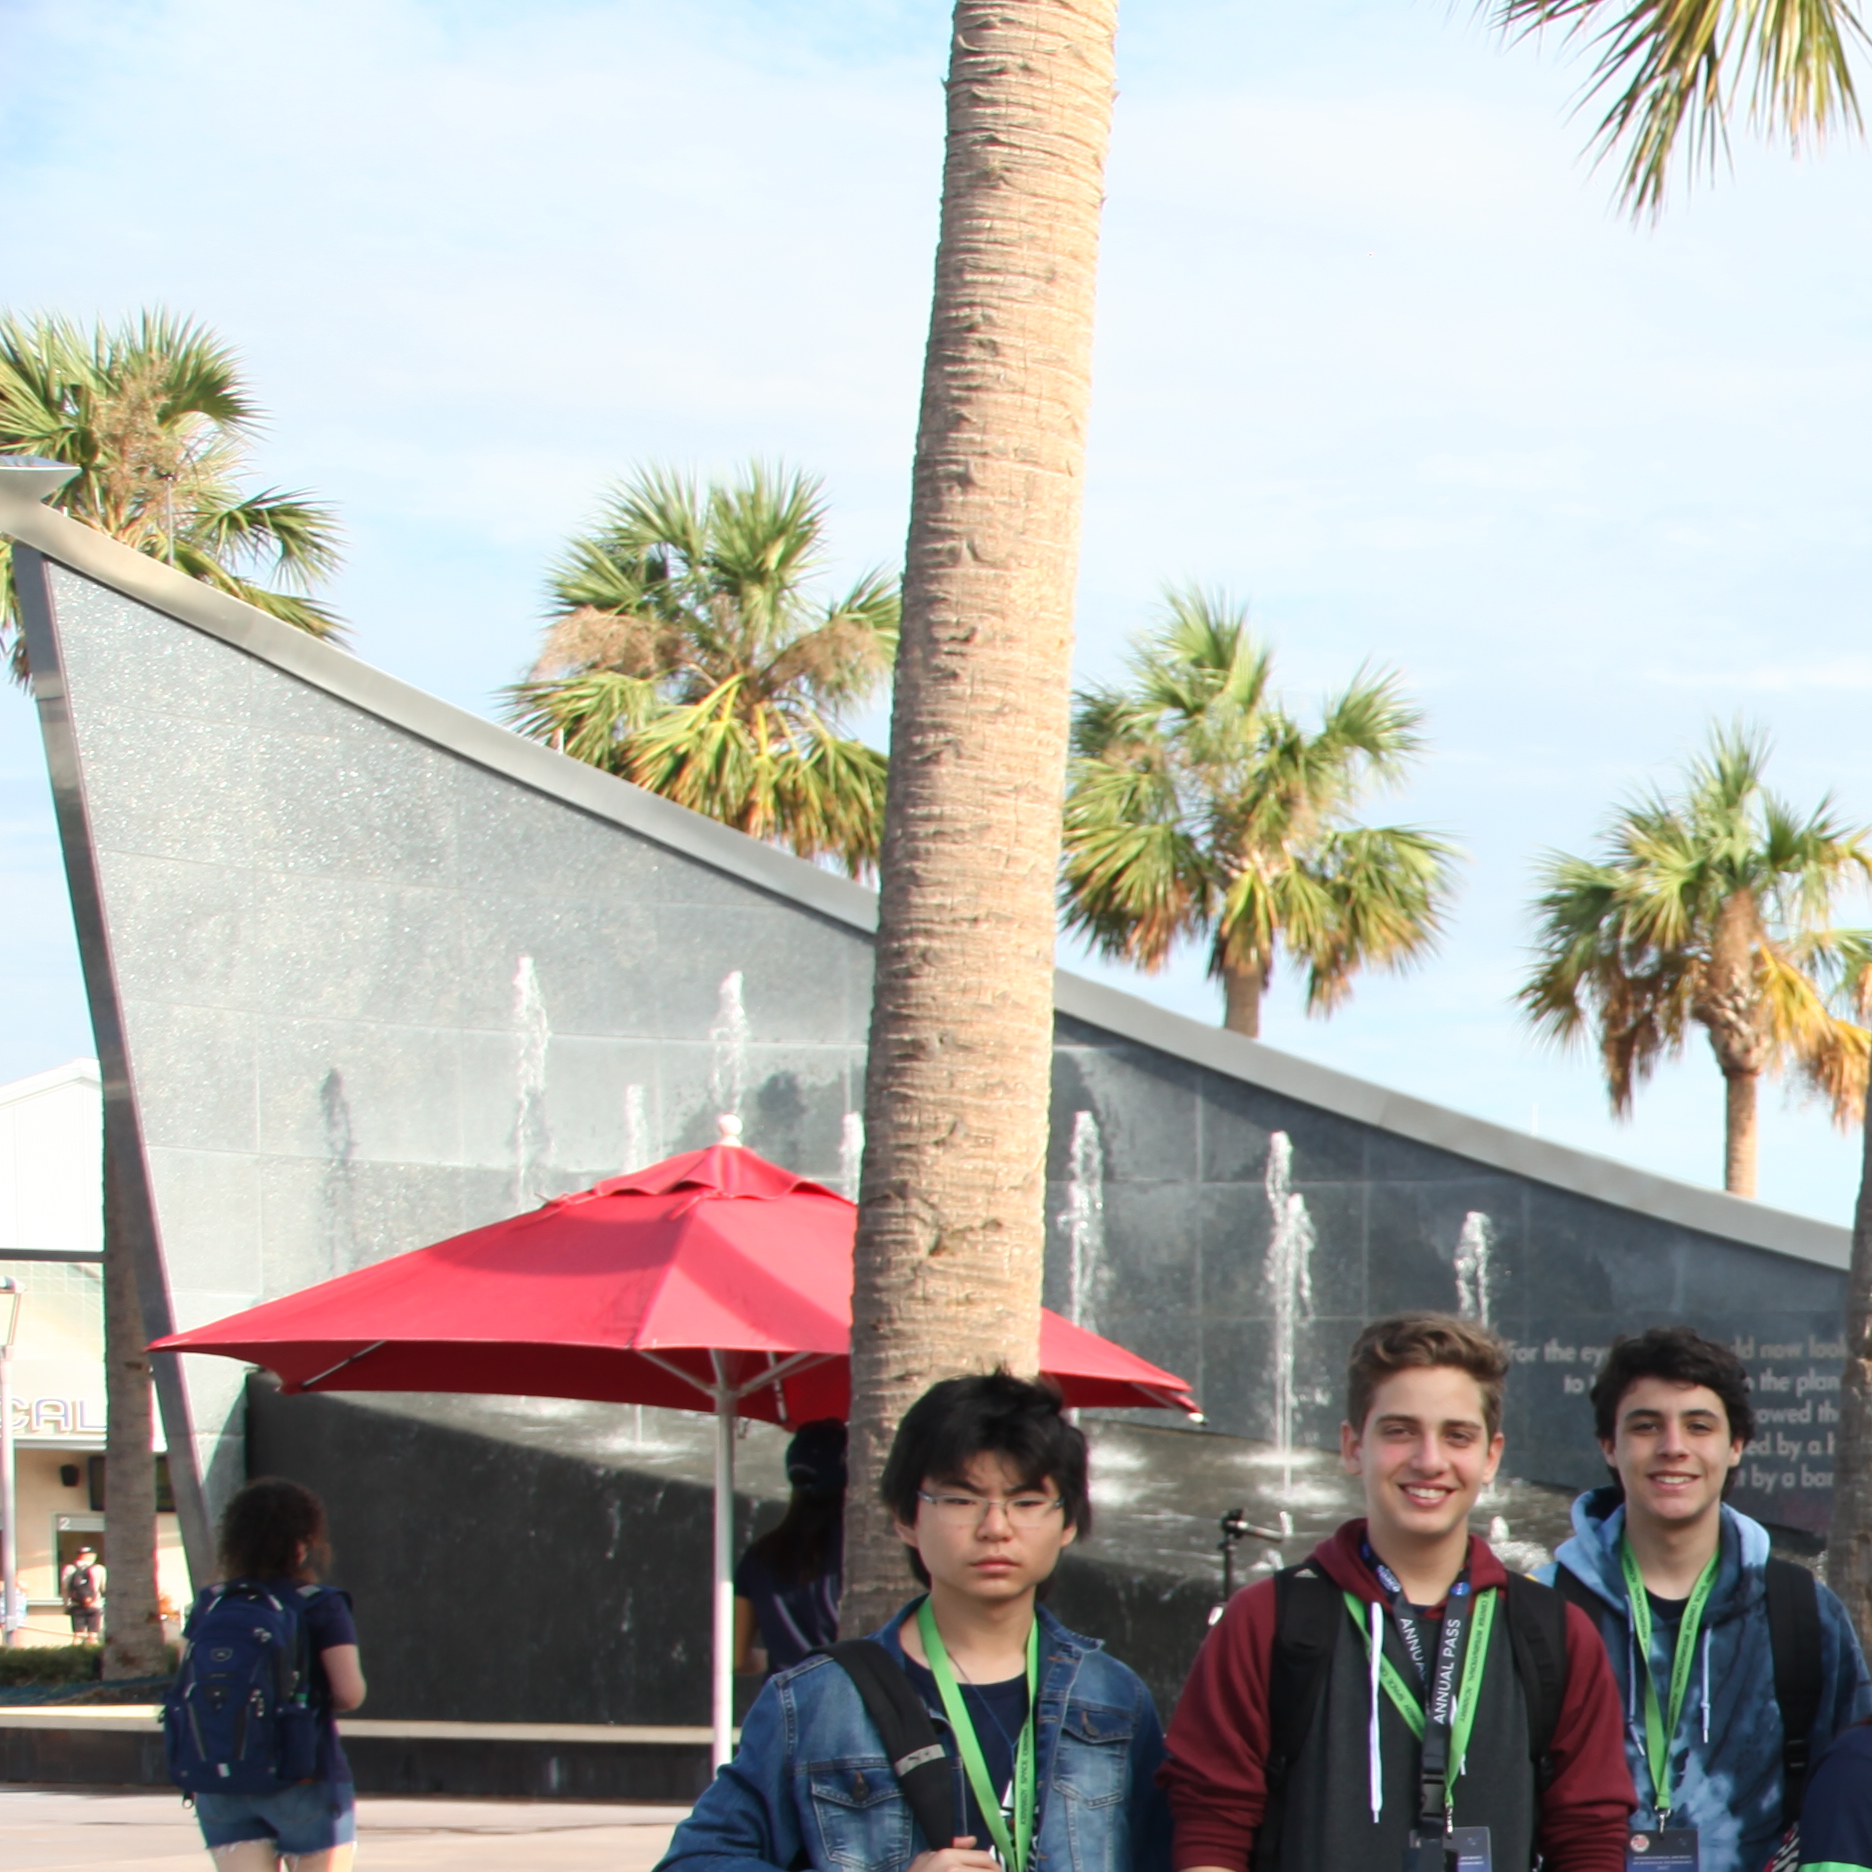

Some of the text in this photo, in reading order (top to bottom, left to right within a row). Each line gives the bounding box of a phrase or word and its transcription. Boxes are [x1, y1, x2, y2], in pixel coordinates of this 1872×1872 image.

[1543, 1338, 1577, 1363] the
[1759, 1343, 1803, 1359] now
[1563, 1374, 1586, 1394] to
[1759, 1367, 1791, 1392] the
[1755, 1399, 1813, 1424] owed
[1776, 1432, 1803, 1463] by
[1806, 1440, 1823, 1456] a
[1751, 1464, 1778, 1494] by
[1780, 1472, 1797, 1488] a
[1433, 1618, 1462, 1725] ANNUAL PASS
